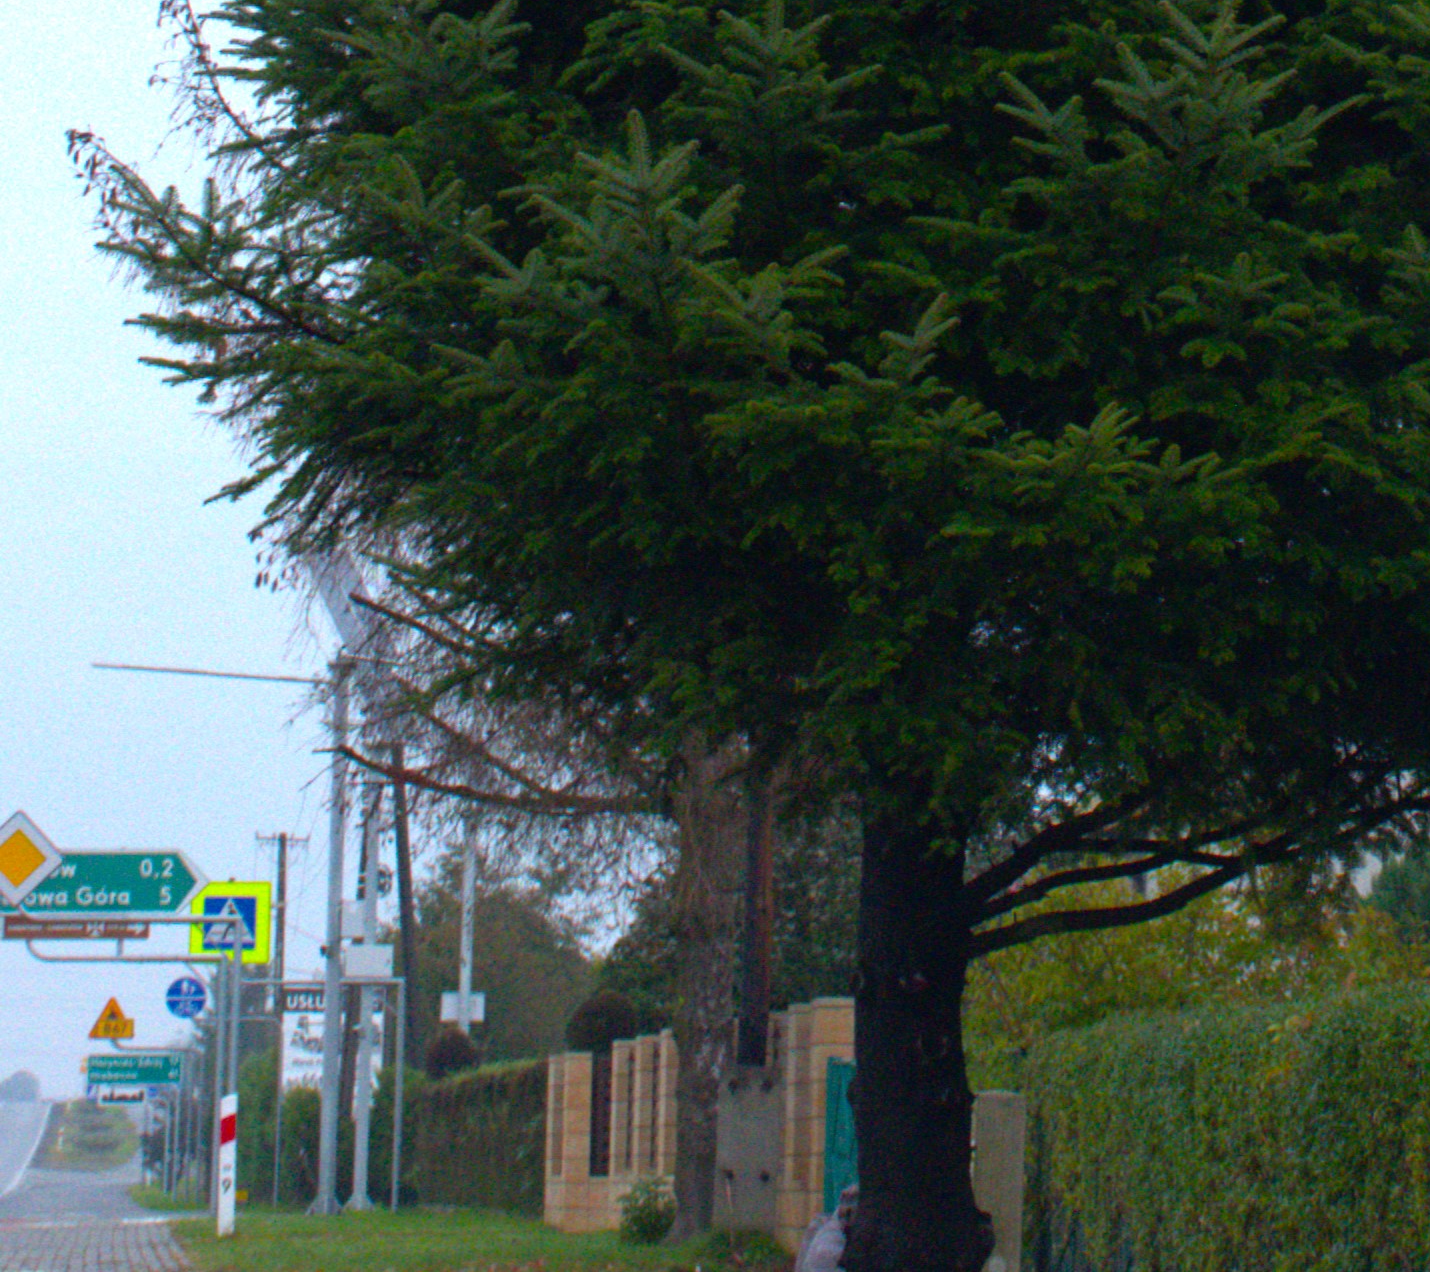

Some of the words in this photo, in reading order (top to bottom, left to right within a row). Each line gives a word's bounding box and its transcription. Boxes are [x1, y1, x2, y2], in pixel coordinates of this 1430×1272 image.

[139, 857, 174, 879] 0,2
[75, 885, 131, 906] Góra
[159, 886, 172, 906] 5
[286, 993, 325, 1010] USŁU
